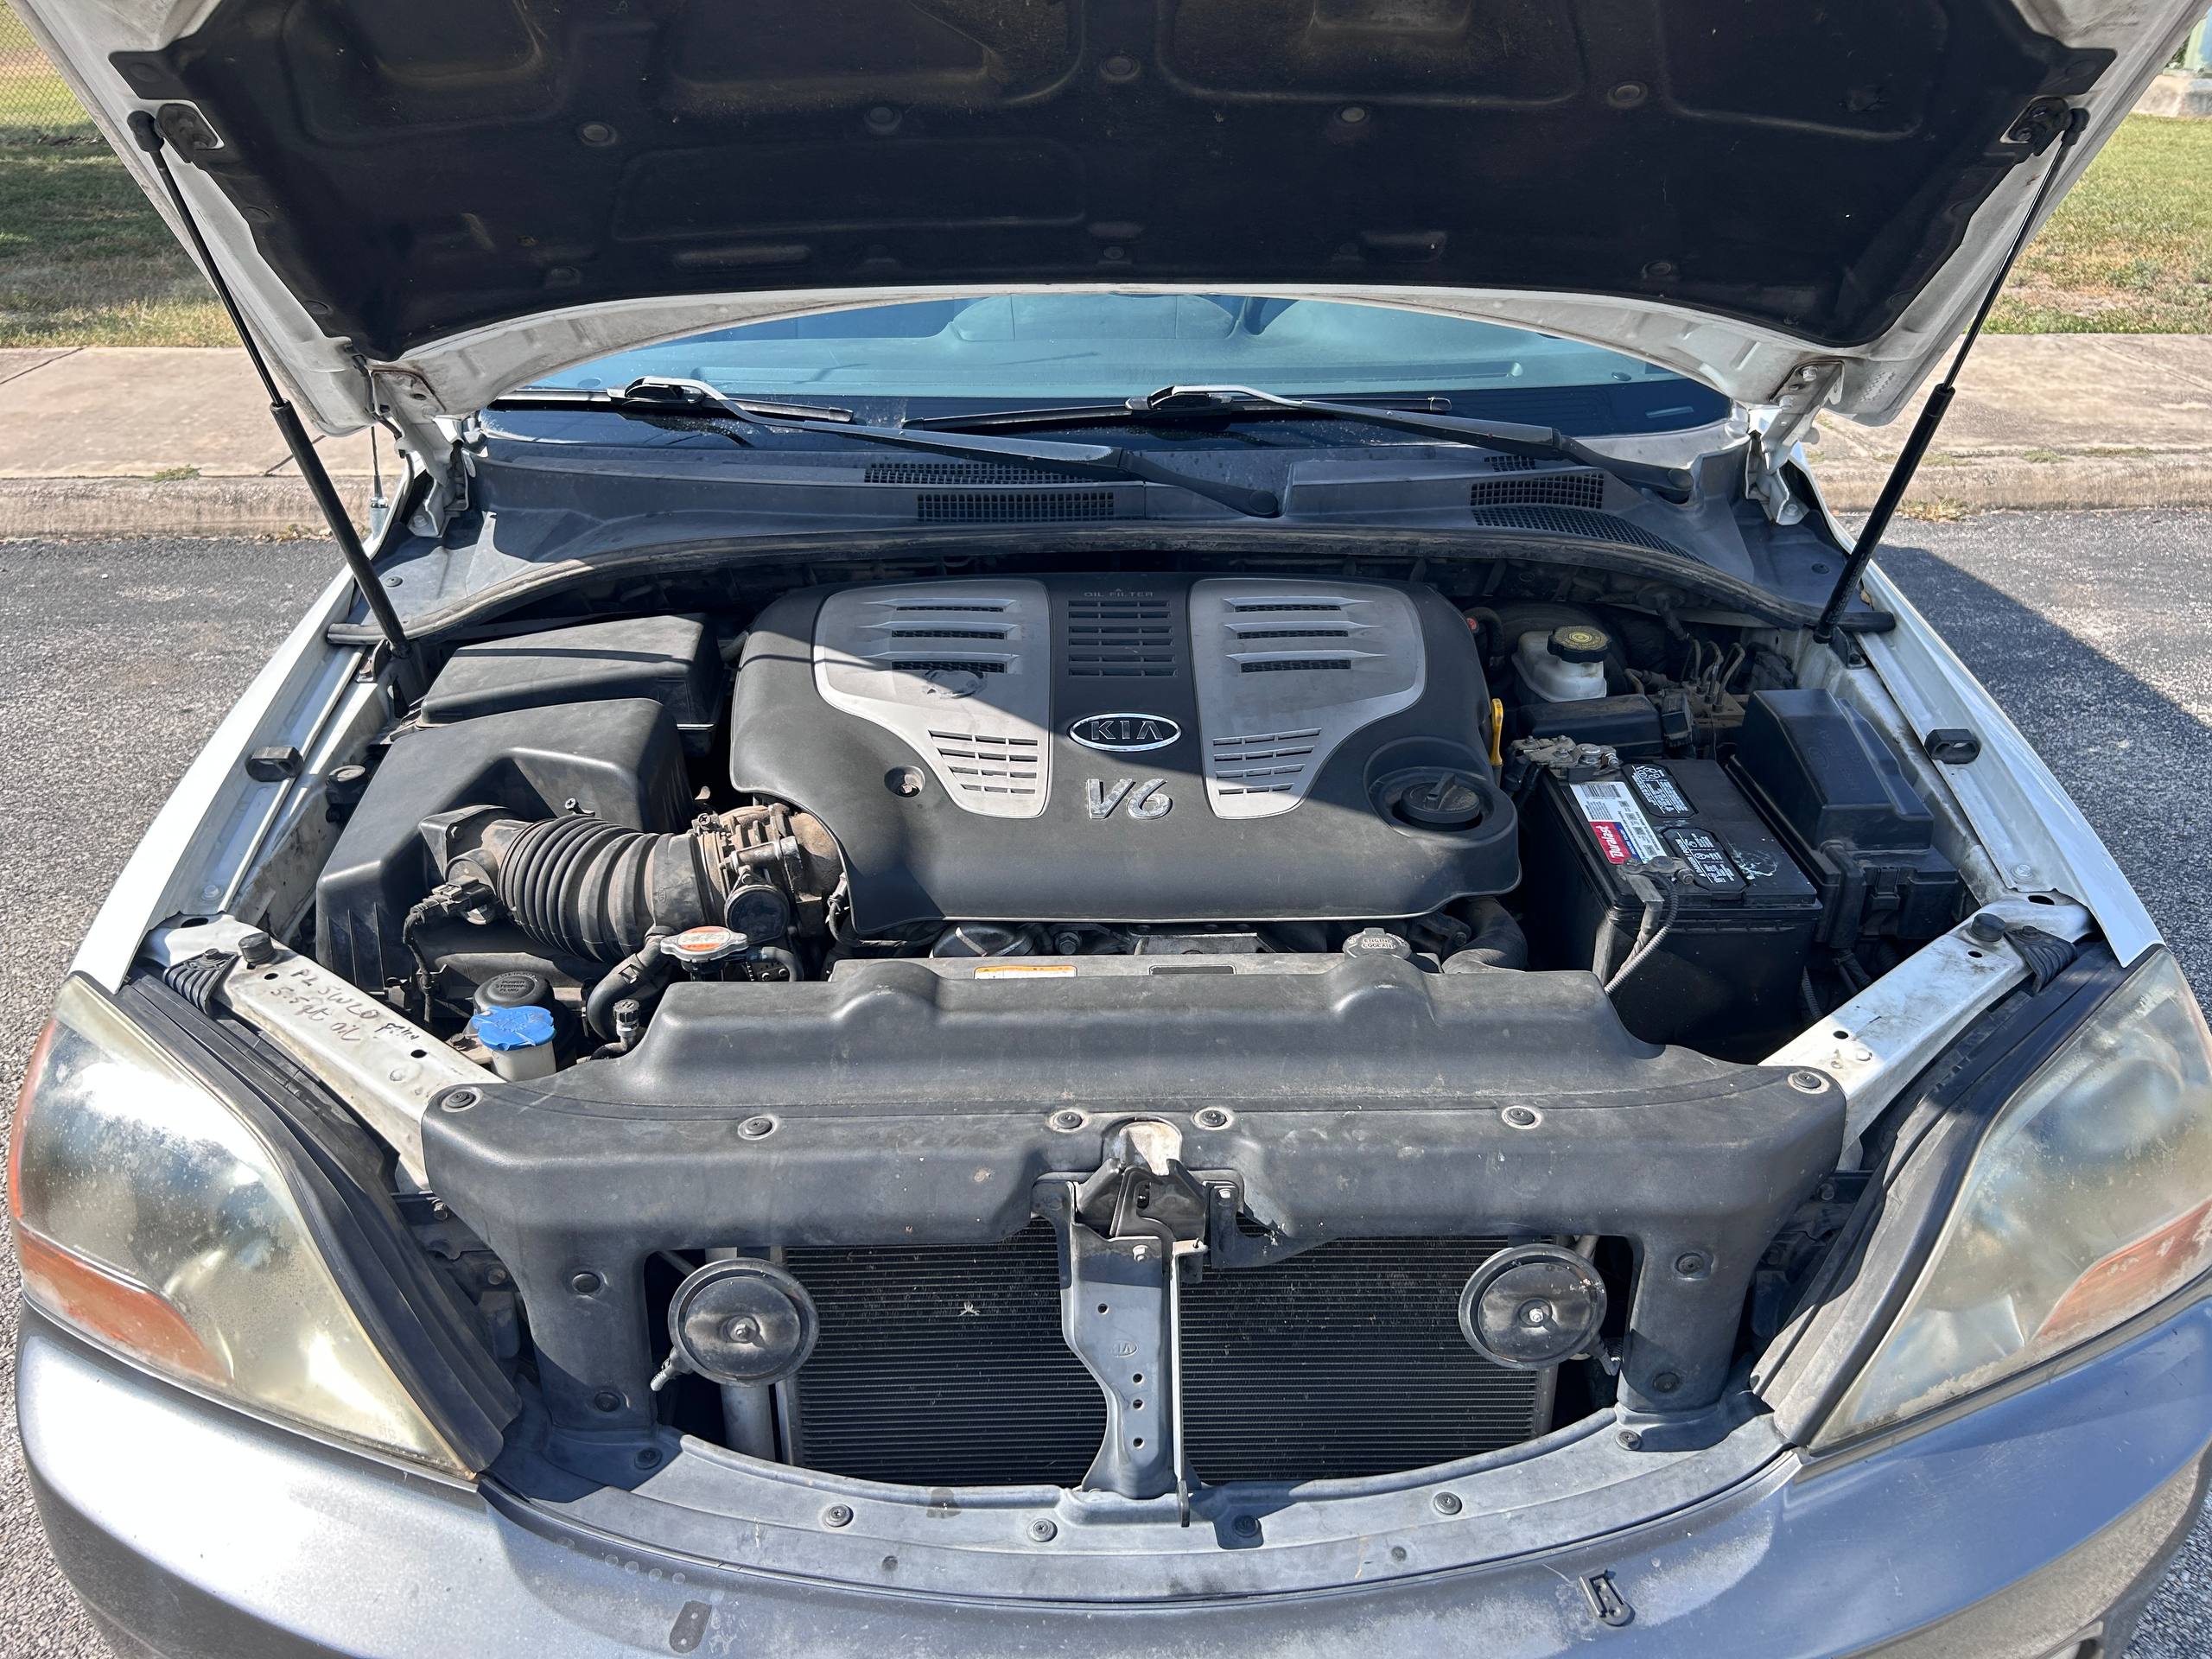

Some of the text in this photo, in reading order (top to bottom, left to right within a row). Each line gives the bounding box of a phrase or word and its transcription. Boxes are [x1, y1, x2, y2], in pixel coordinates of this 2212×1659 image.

[1090, 721, 1163, 741] KIA
[1087, 778, 1174, 820] V6
[1595, 825, 1624, 859] Duralast
